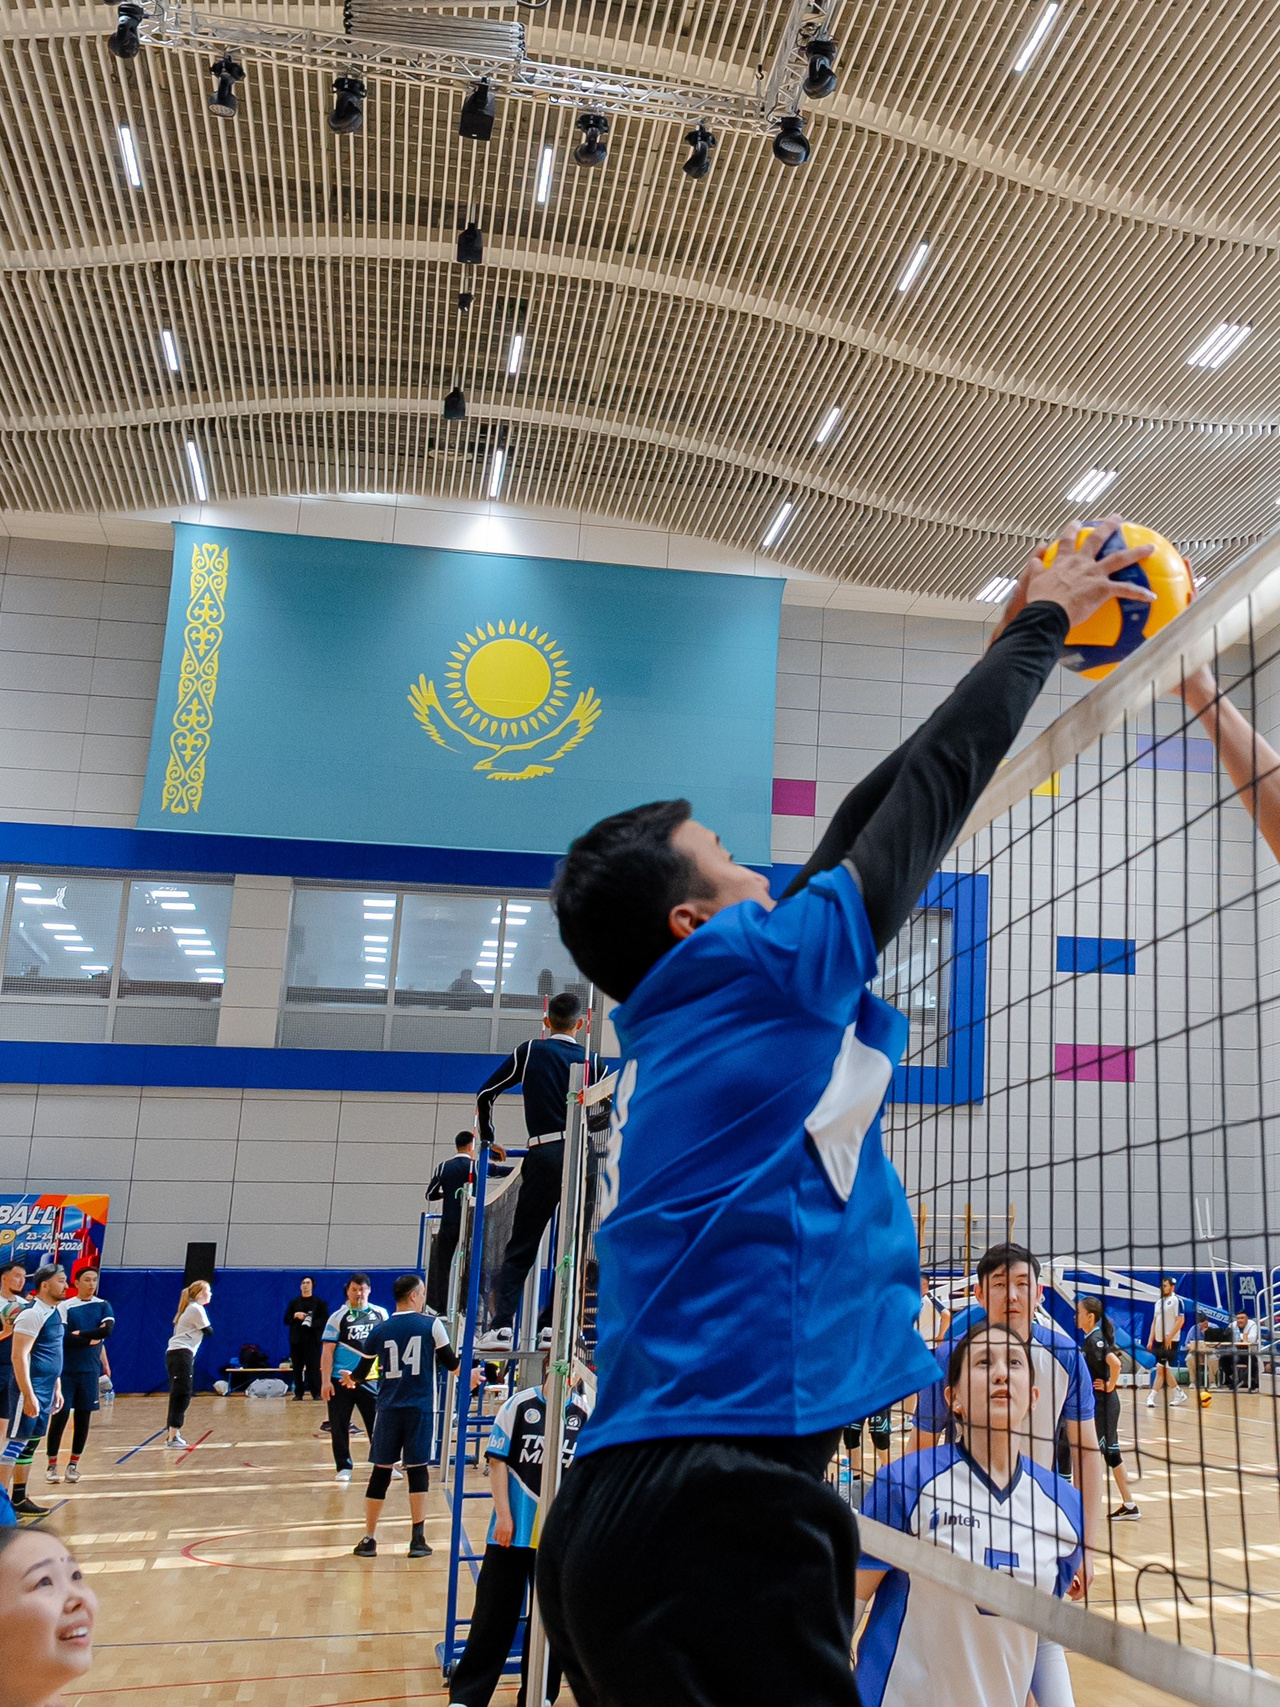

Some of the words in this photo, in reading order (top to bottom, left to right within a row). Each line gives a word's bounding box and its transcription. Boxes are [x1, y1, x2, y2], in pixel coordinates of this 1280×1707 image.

[54, 1232, 76, 1240] MAY
[16, 1242, 58, 1250] ASTANA
[58, 1242, 84, 1250] 2026
[384, 1335, 422, 1379] 14
[943, 1512, 981, 1528] Inteh
